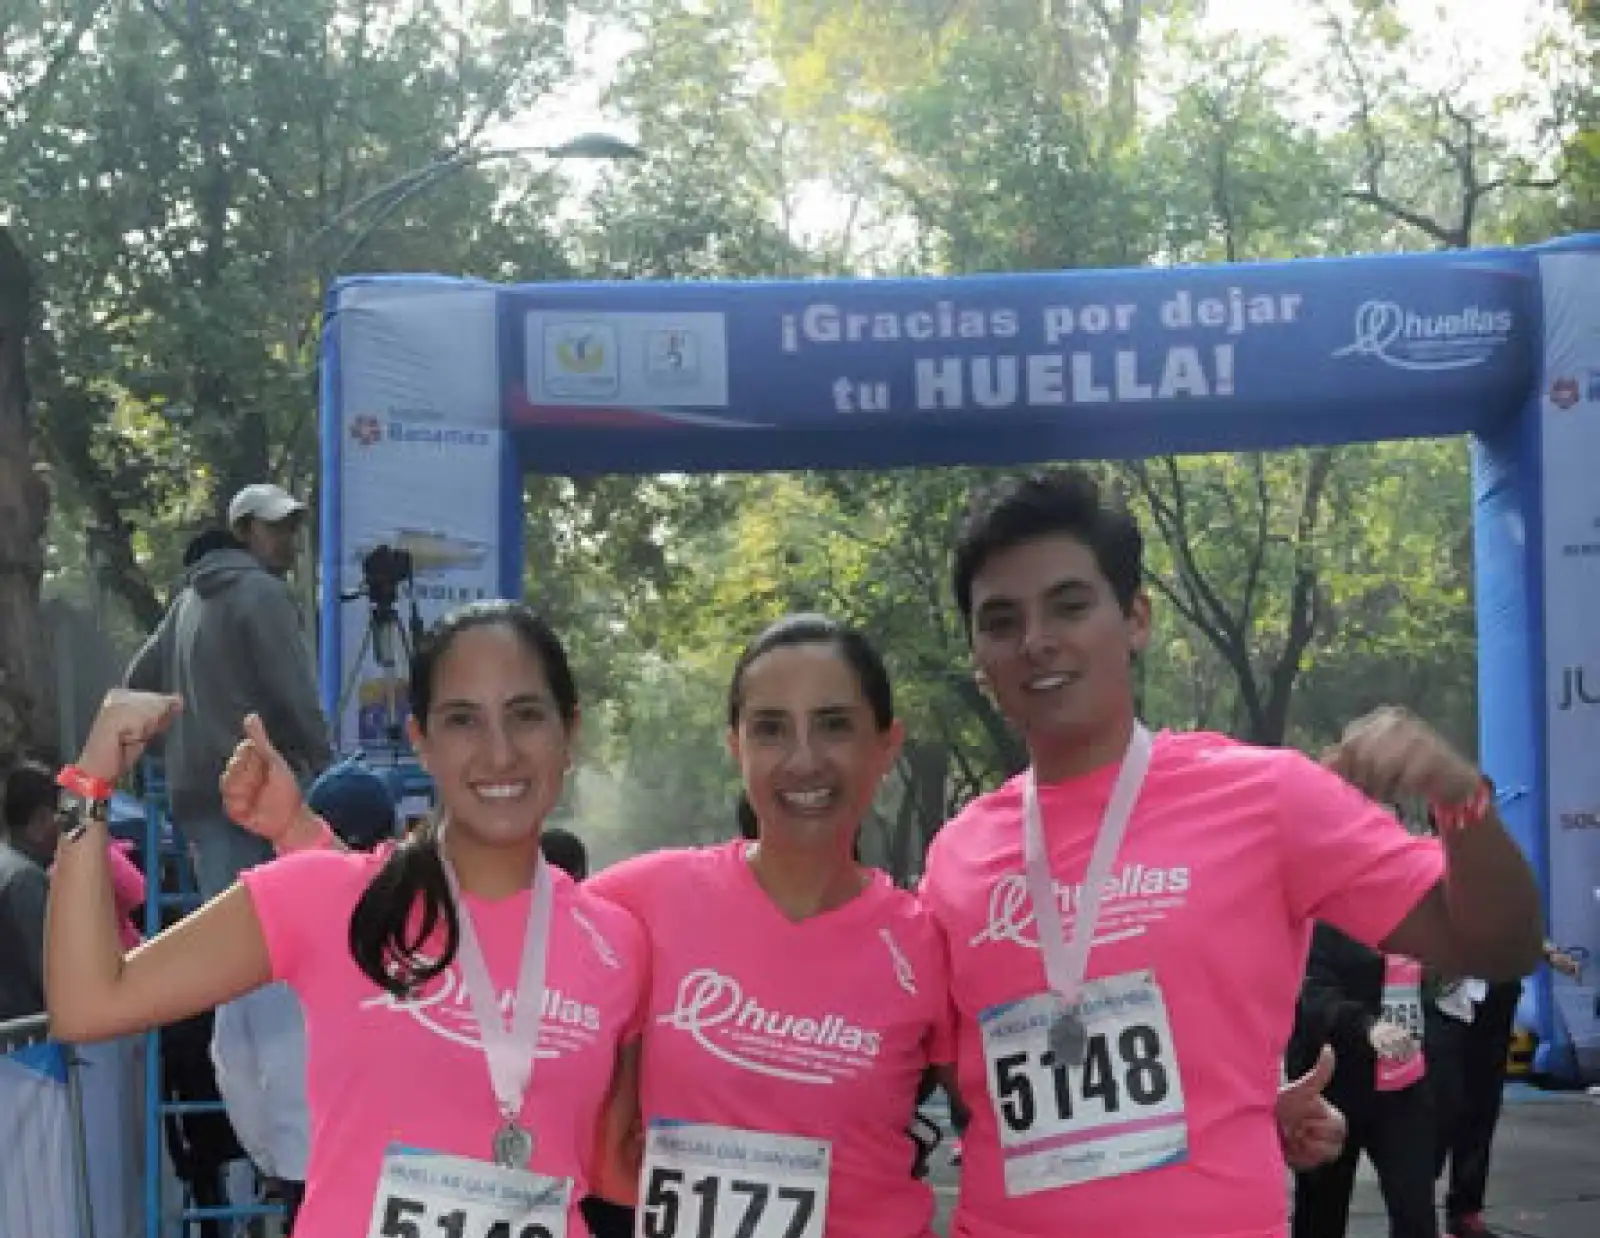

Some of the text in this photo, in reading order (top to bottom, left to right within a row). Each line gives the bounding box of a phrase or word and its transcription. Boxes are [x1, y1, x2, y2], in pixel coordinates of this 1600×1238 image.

[1044, 304, 1138, 345] por
[1161, 287, 1303, 334] dejar
[832, 344, 1235, 413] tu HUELLA!
[736, 997, 881, 1056] huellas
[996, 1024, 1169, 1132] 5148
